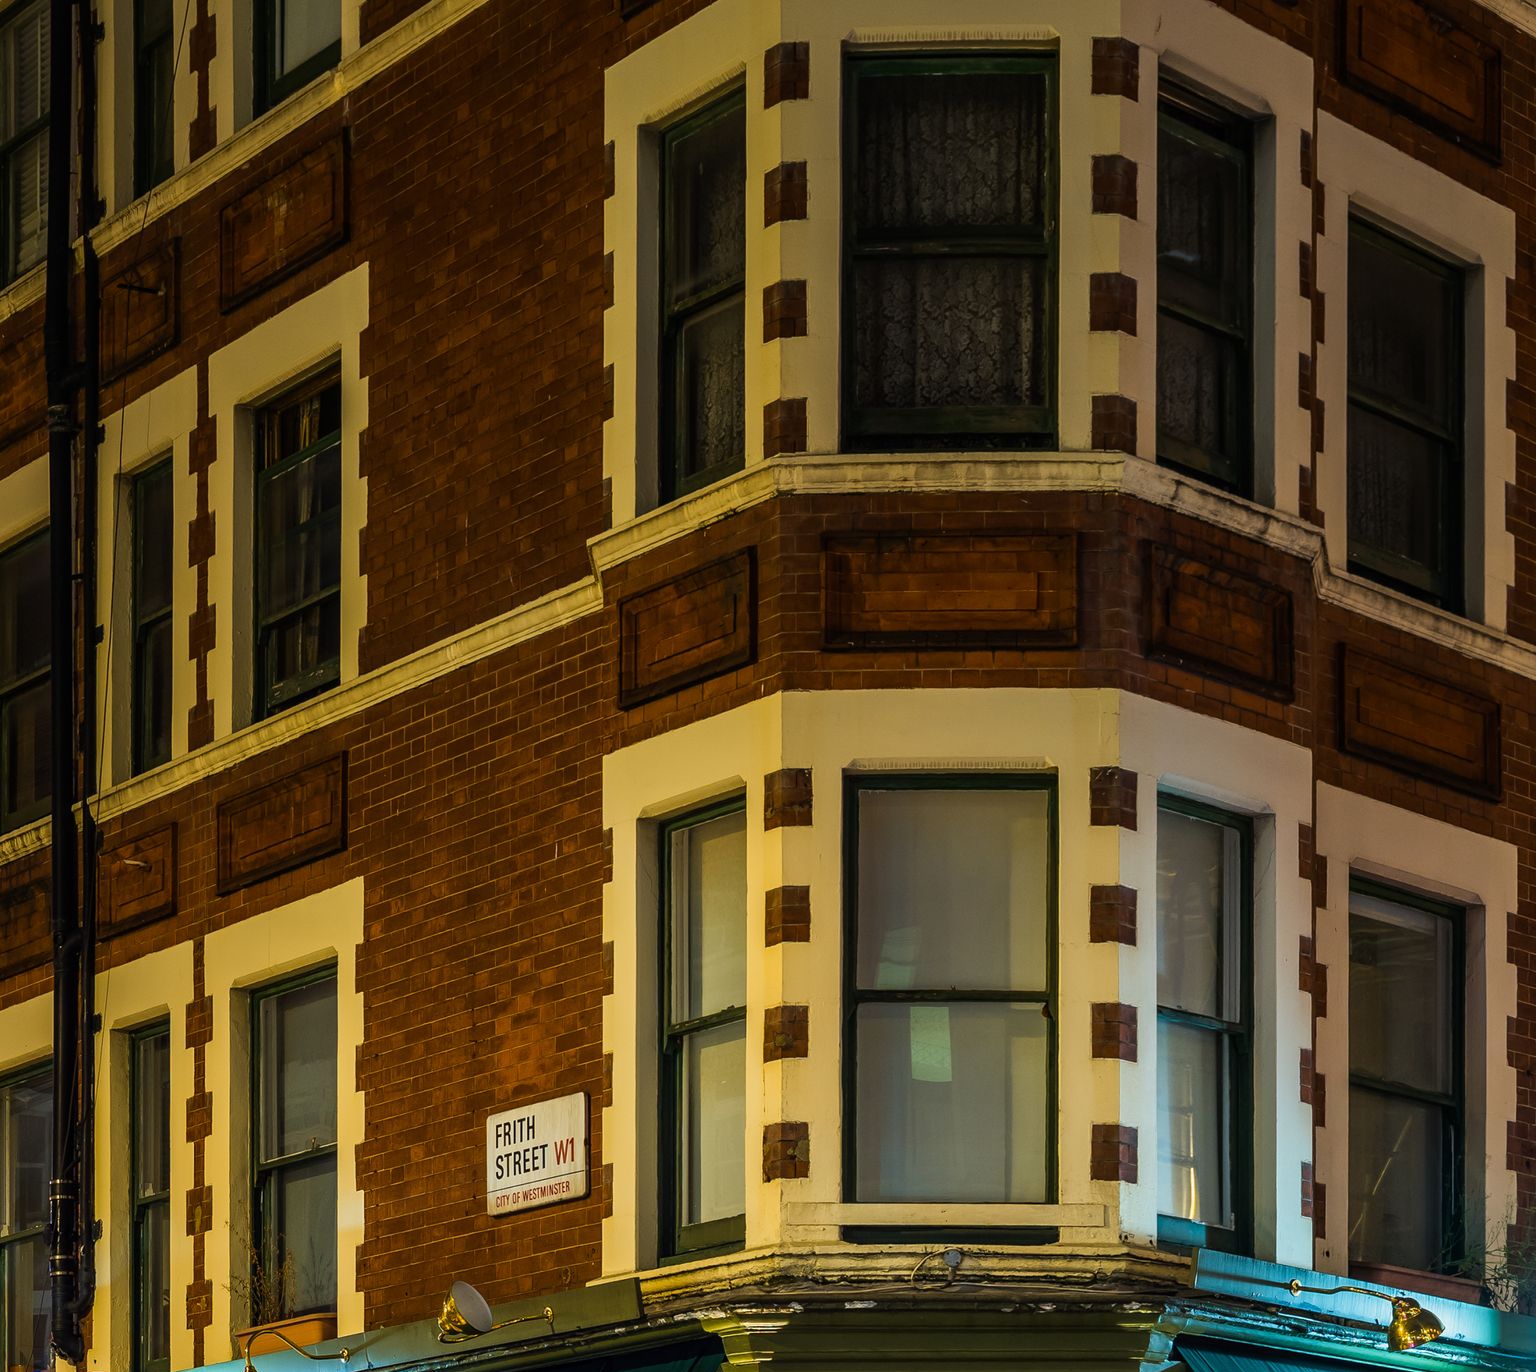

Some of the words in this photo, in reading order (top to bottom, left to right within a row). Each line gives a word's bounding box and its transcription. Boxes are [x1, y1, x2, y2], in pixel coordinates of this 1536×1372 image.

[495, 1115, 536, 1148] FRITH
[495, 1144, 548, 1180] STREET
[554, 1137, 575, 1165] W1
[496, 1195, 510, 1208] CITY
[512, 1191, 521, 1204] OF
[522, 1180, 571, 1202] WESTMINSTER
